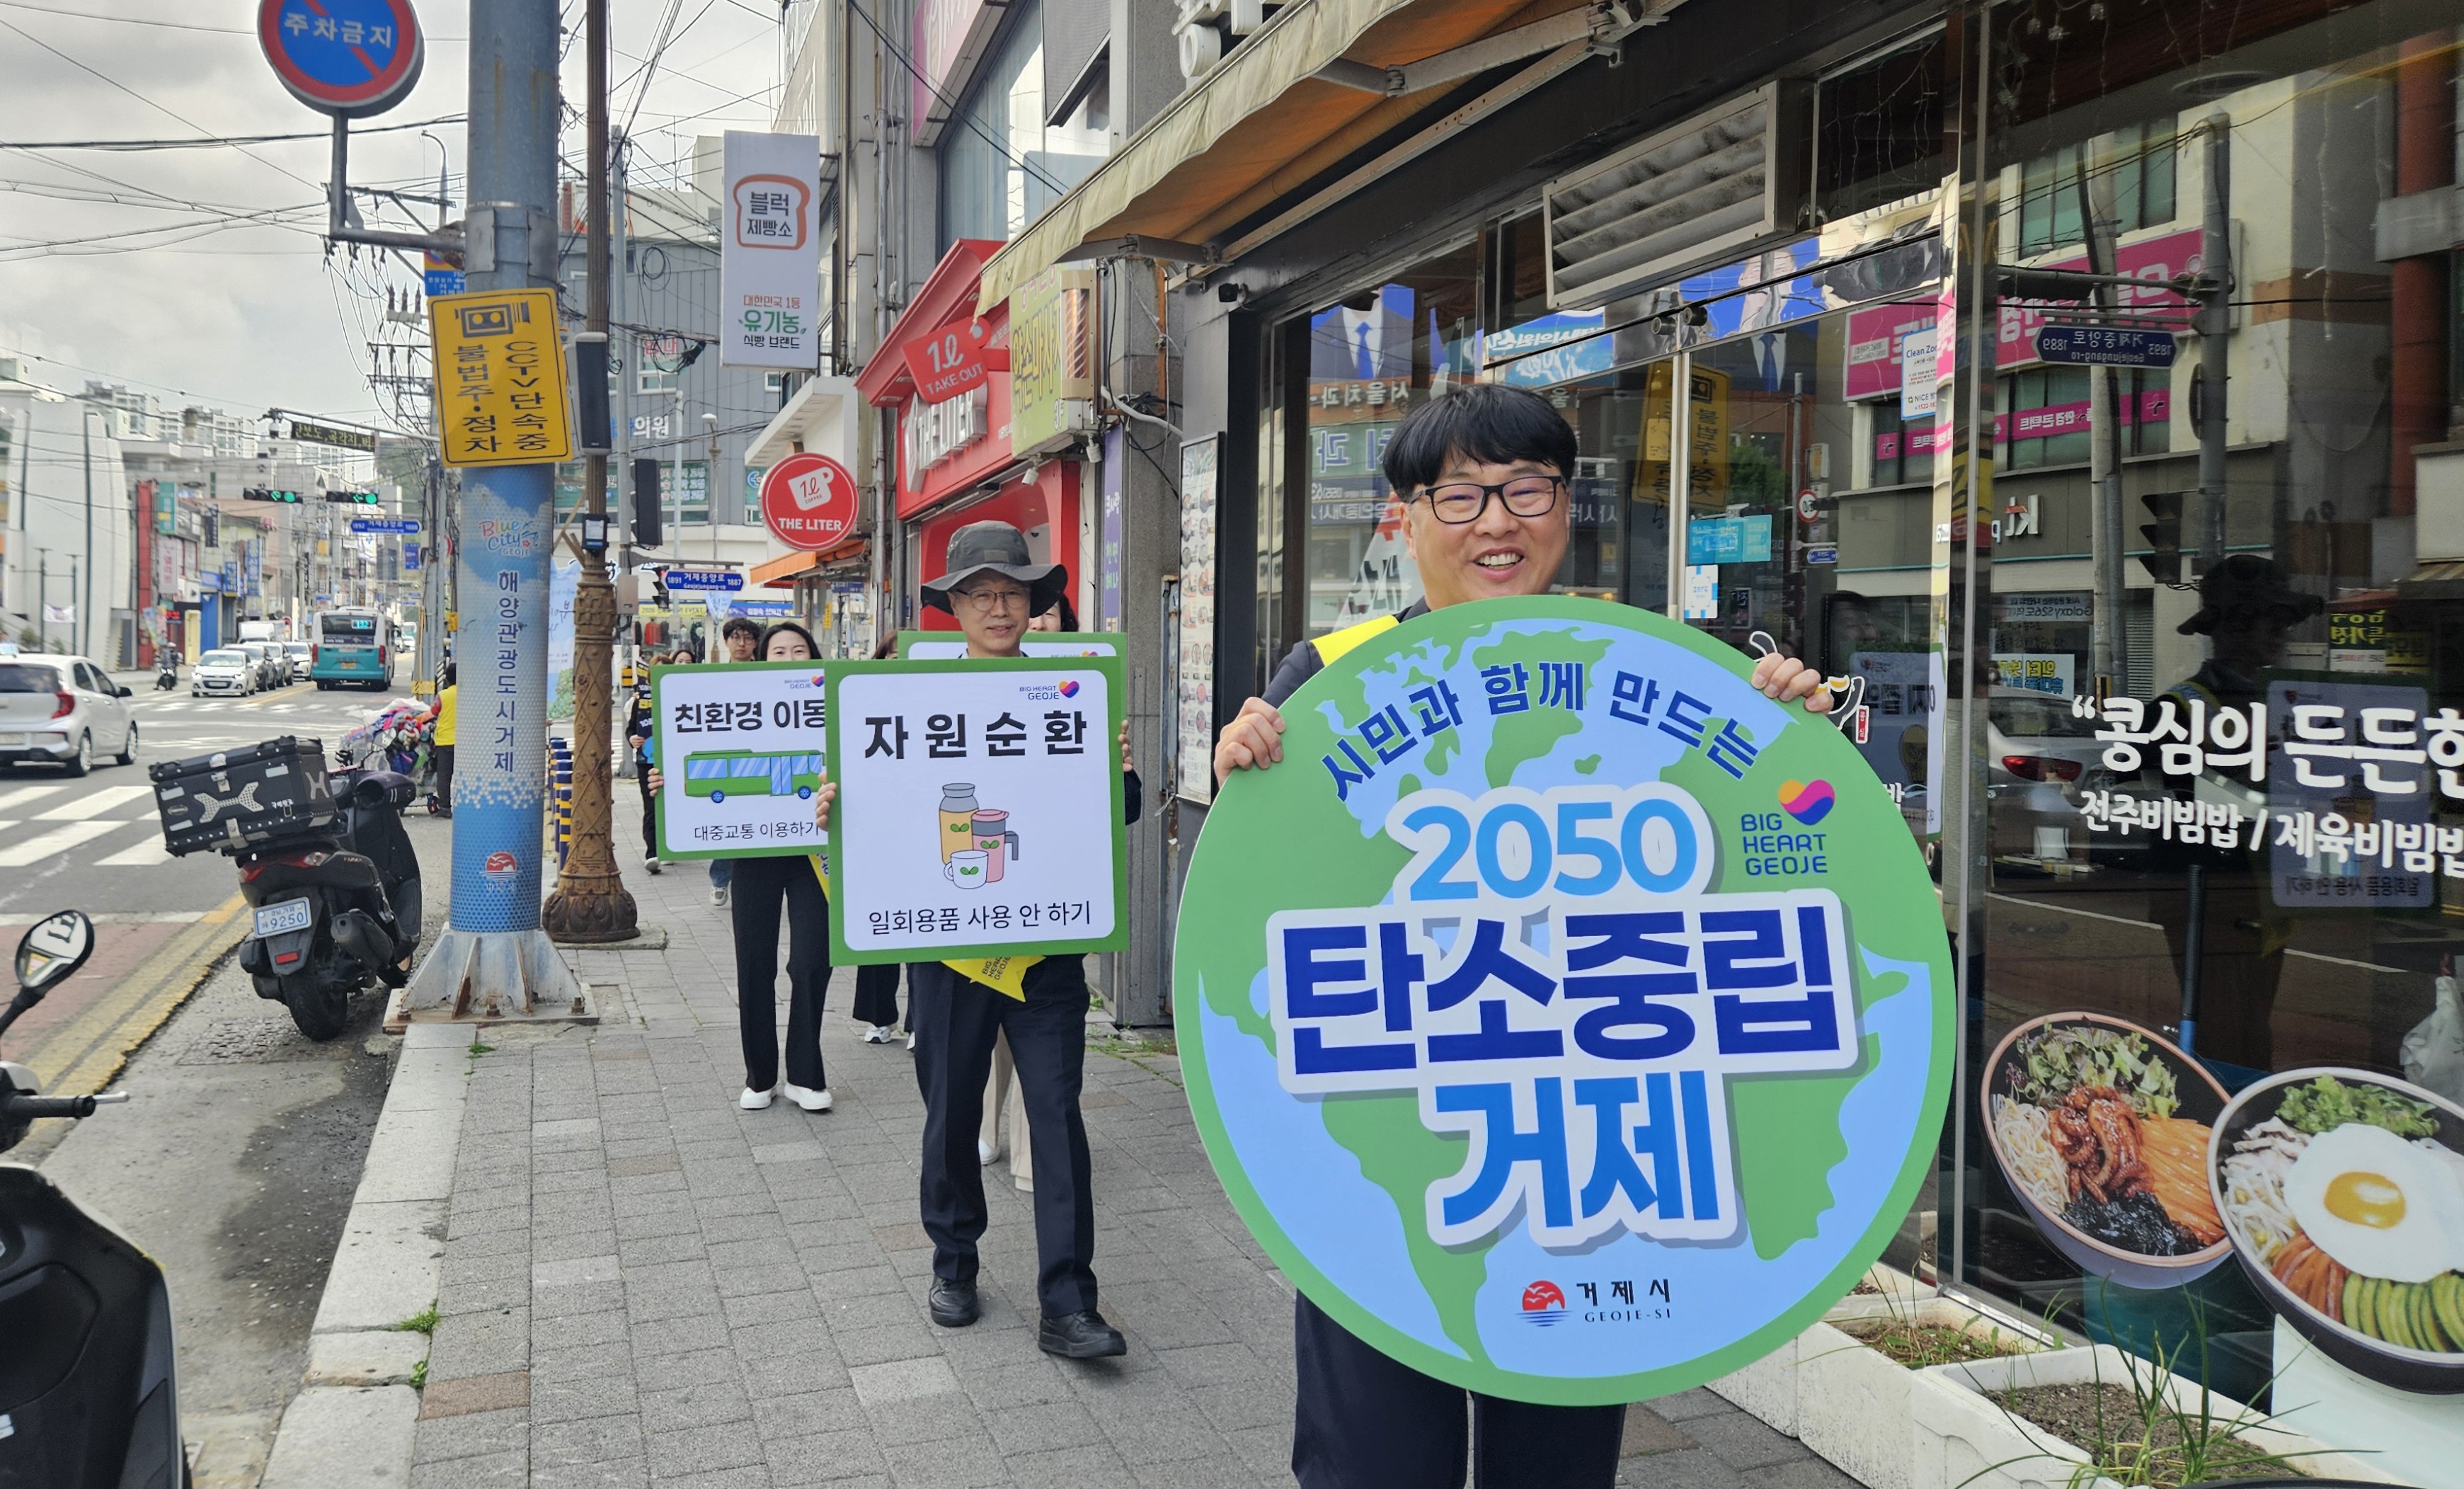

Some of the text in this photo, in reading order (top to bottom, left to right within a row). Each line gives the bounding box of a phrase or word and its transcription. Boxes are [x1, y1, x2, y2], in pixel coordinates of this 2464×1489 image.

[284, 11, 392, 49] 주차금지
[750, 191, 789, 217] 블럭
[747, 218, 793, 237] 제빵소
[743, 295, 801, 309] 대한민국 1등
[744, 309, 801, 335] 유기농
[743, 335, 801, 349] 식빵 브랜드
[1906, 348, 1925, 358] Clean
[925, 363, 984, 396] TAKE OUT
[1914, 394, 1930, 402] NICE
[805, 494, 823, 504] COFFEE
[479, 516, 522, 537] Blue
[778, 517, 842, 532] THE LITER
[487, 533, 522, 551] City
[502, 547, 531, 558] GEOJE
[667, 576, 682, 585] 1891
[683, 572, 726, 583] 거제중앙로
[727, 578, 742, 587] 1887
[1028, 692, 1060, 700] GEOJE
[675, 699, 825, 734] 친환경 이동
[1319, 661, 1760, 804] 시민과 함께 만드는
[1740, 814, 1782, 832] BIG
[2080, 789, 2245, 848] 전주비빔밥
[694, 821, 820, 841] 대중교통 이용하기
[1402, 798, 1699, 902] 2050
[1742, 833, 1828, 854] HEART
[1745, 855, 1828, 877] GEOJE
[270, 912, 304, 930] 9250
[868, 900, 1091, 935] 일회용품 사용 안 하기
[1282, 904, 1841, 1076] 탄소중립
[1434, 1069, 1721, 1230] 거제
[1576, 1278, 1671, 1307] 거제시
[1584, 1308, 1671, 1323] GEOJE-SI
